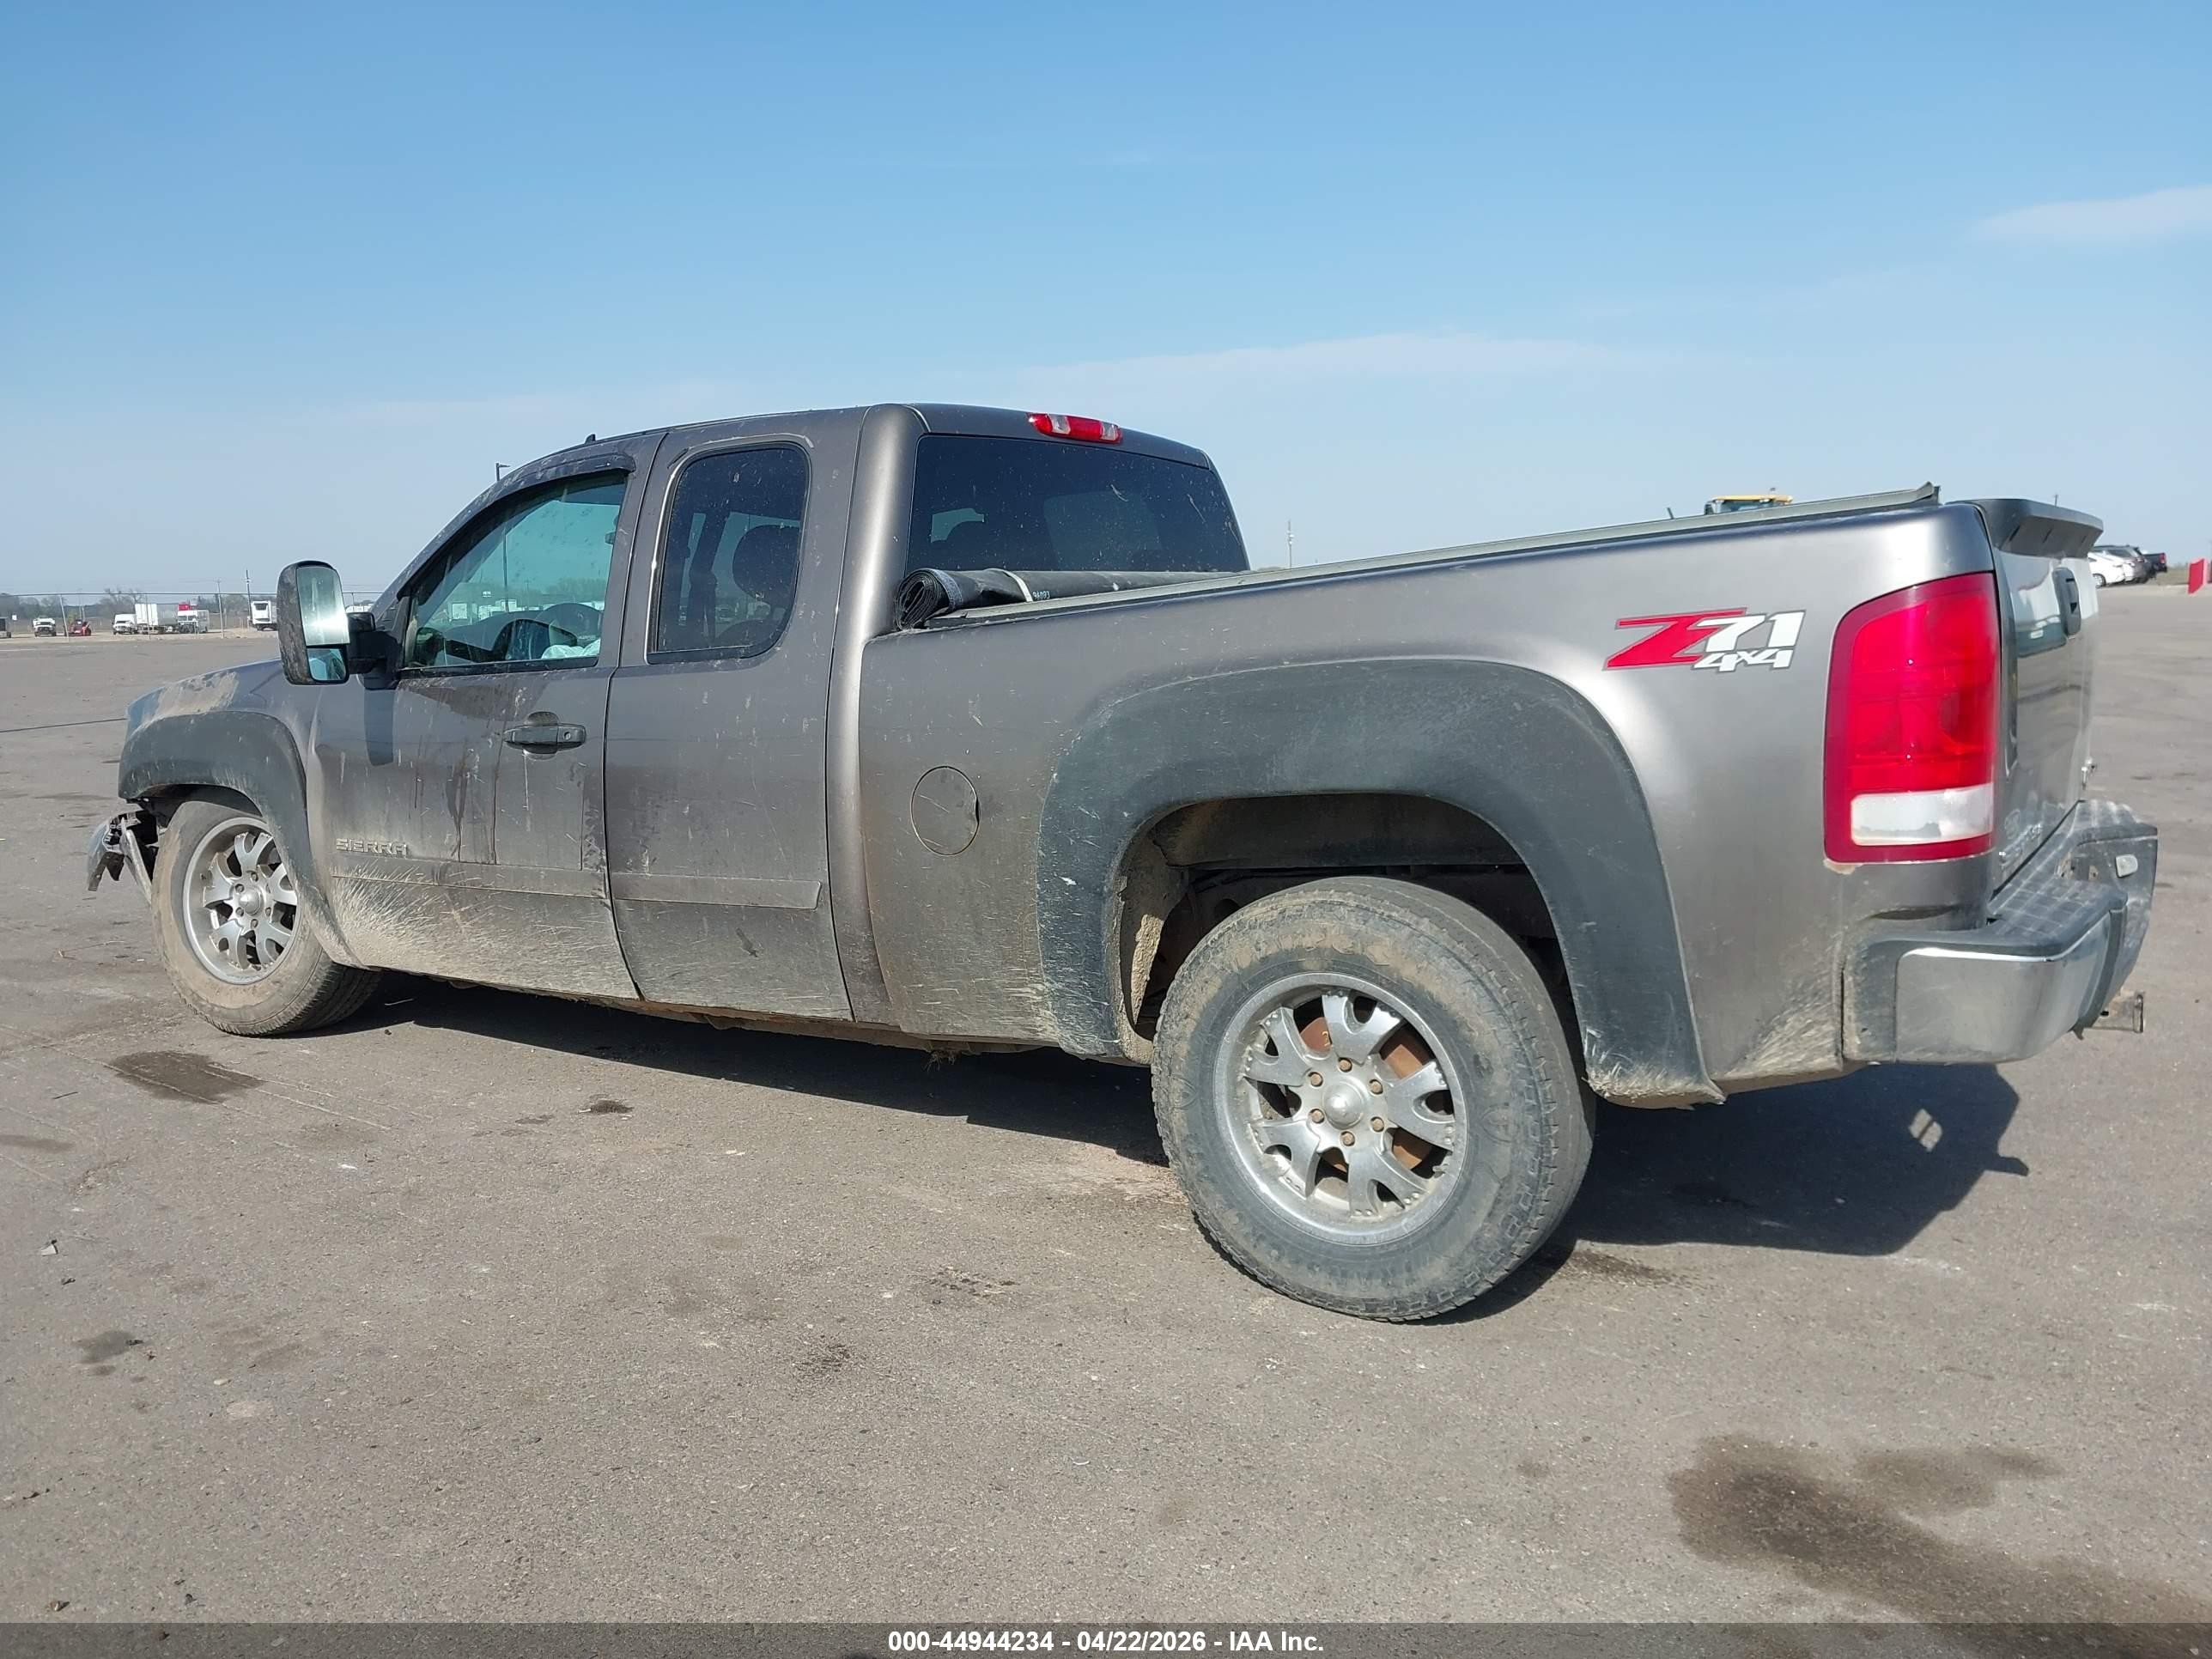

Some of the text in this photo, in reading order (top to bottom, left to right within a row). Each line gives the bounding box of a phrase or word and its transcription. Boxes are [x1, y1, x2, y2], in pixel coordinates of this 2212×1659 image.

[1603, 607, 1806, 671] Z71
[1691, 647, 1795, 672] 4x4
[336, 838, 408, 855] SIERRA
